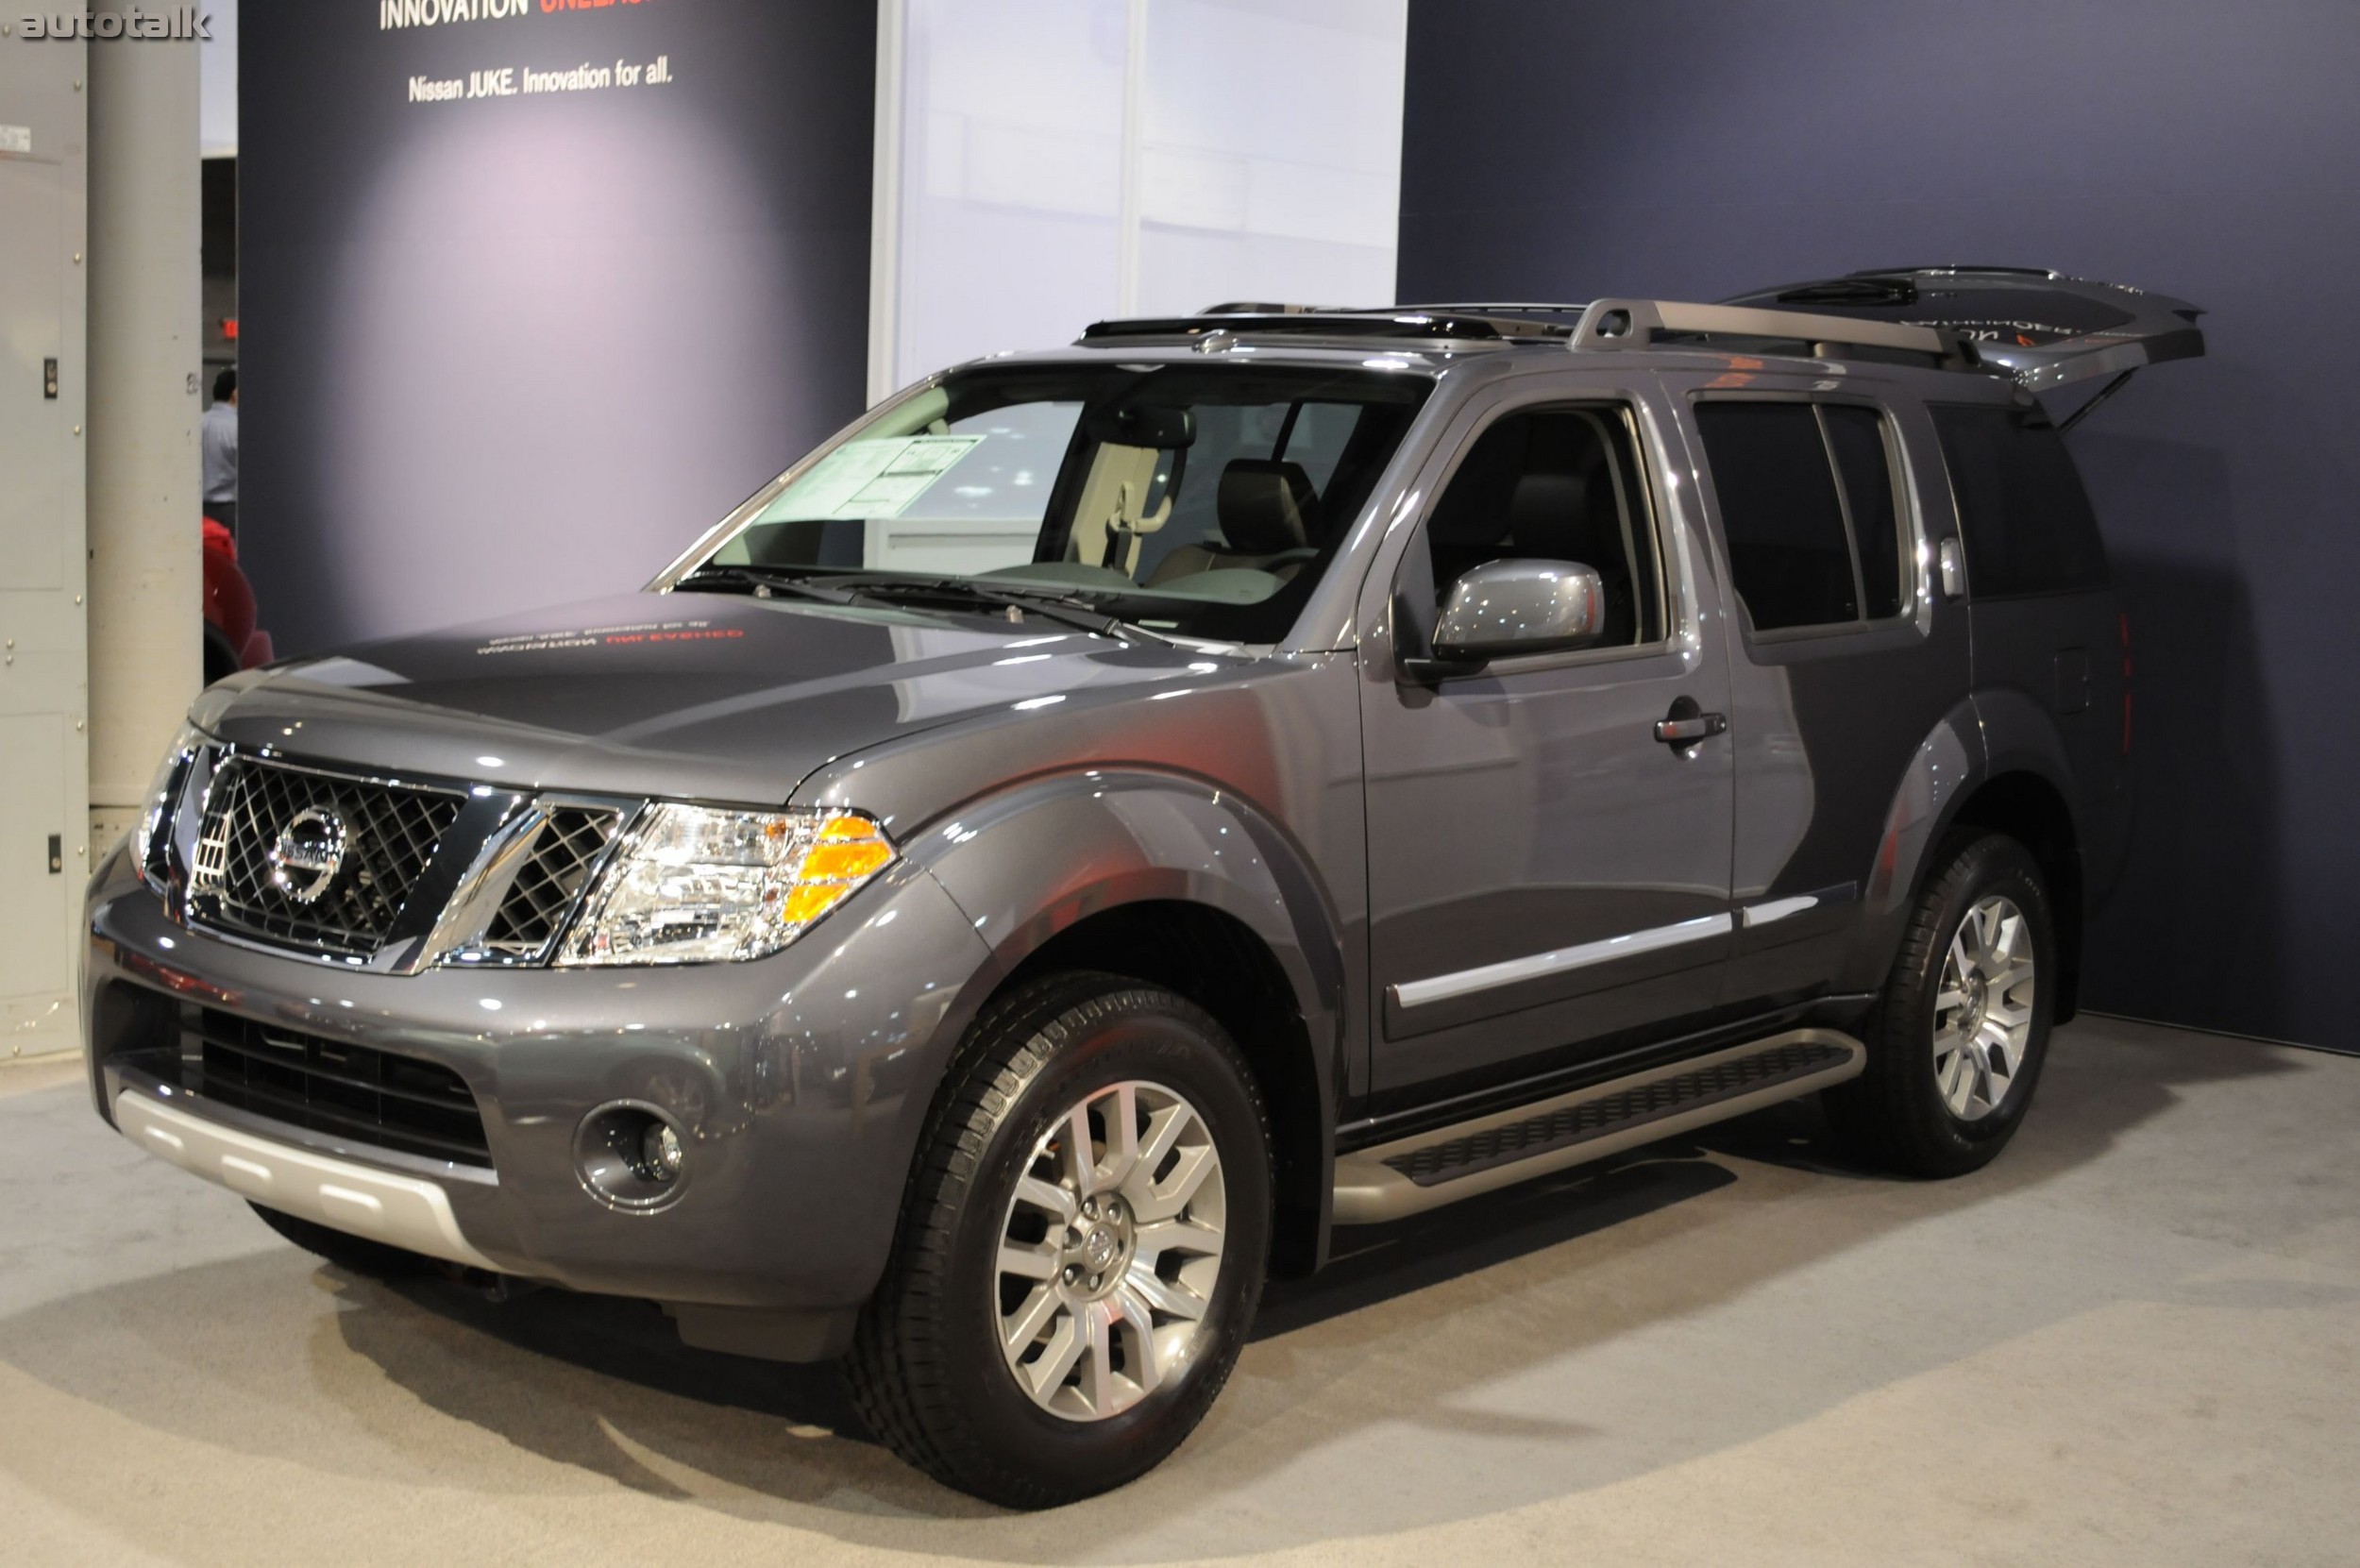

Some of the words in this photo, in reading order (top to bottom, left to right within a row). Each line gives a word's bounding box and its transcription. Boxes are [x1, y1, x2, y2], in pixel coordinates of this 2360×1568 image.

[408, 75, 464, 102] Nissan
[466, 67, 517, 98] JUKE.
[523, 61, 610, 93] Innovation
[615, 58, 642, 86] for
[646, 55, 673, 84] all.
